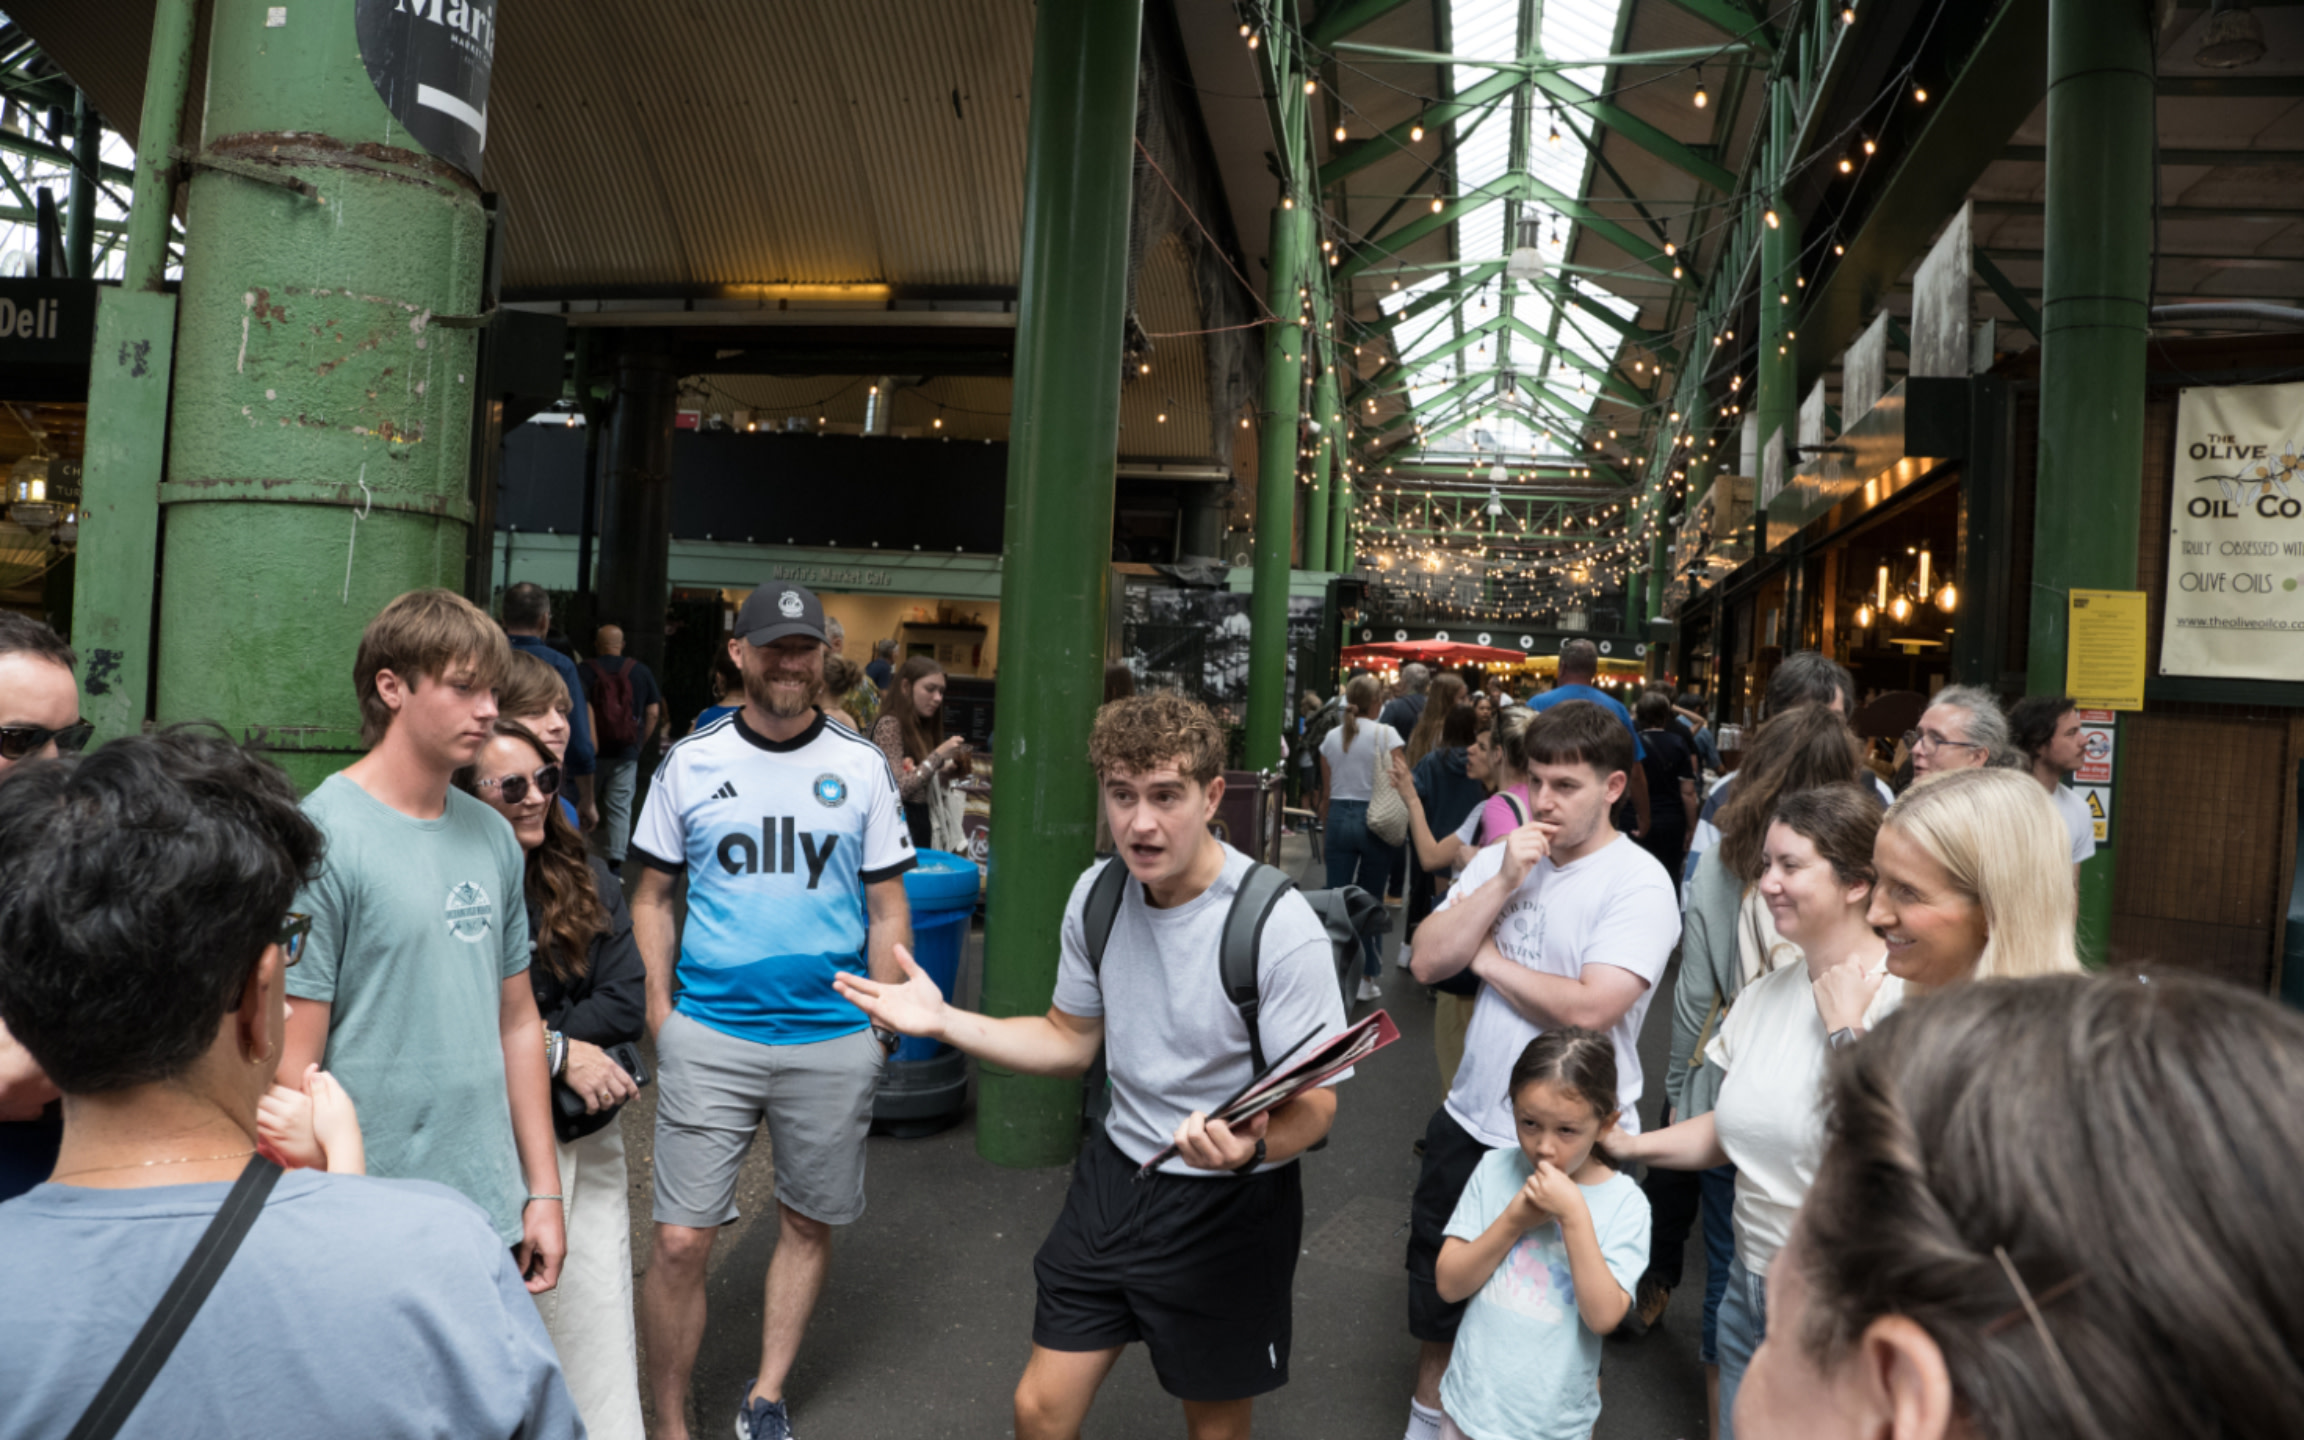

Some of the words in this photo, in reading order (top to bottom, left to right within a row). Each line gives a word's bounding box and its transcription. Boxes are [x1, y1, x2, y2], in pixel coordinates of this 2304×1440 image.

[0, 297, 58, 339] Deli
[2207, 433, 2235, 444] THE
[2189, 442, 2268, 460] OLIVE
[2187, 497, 2239, 519] OIL
[2181, 541, 2212, 555] TRULY
[2220, 541, 2279, 556] OBSESSED
[2179, 572, 2226, 592] OLIVE
[2232, 572, 2273, 594] OILS
[716, 816, 840, 890] ally
